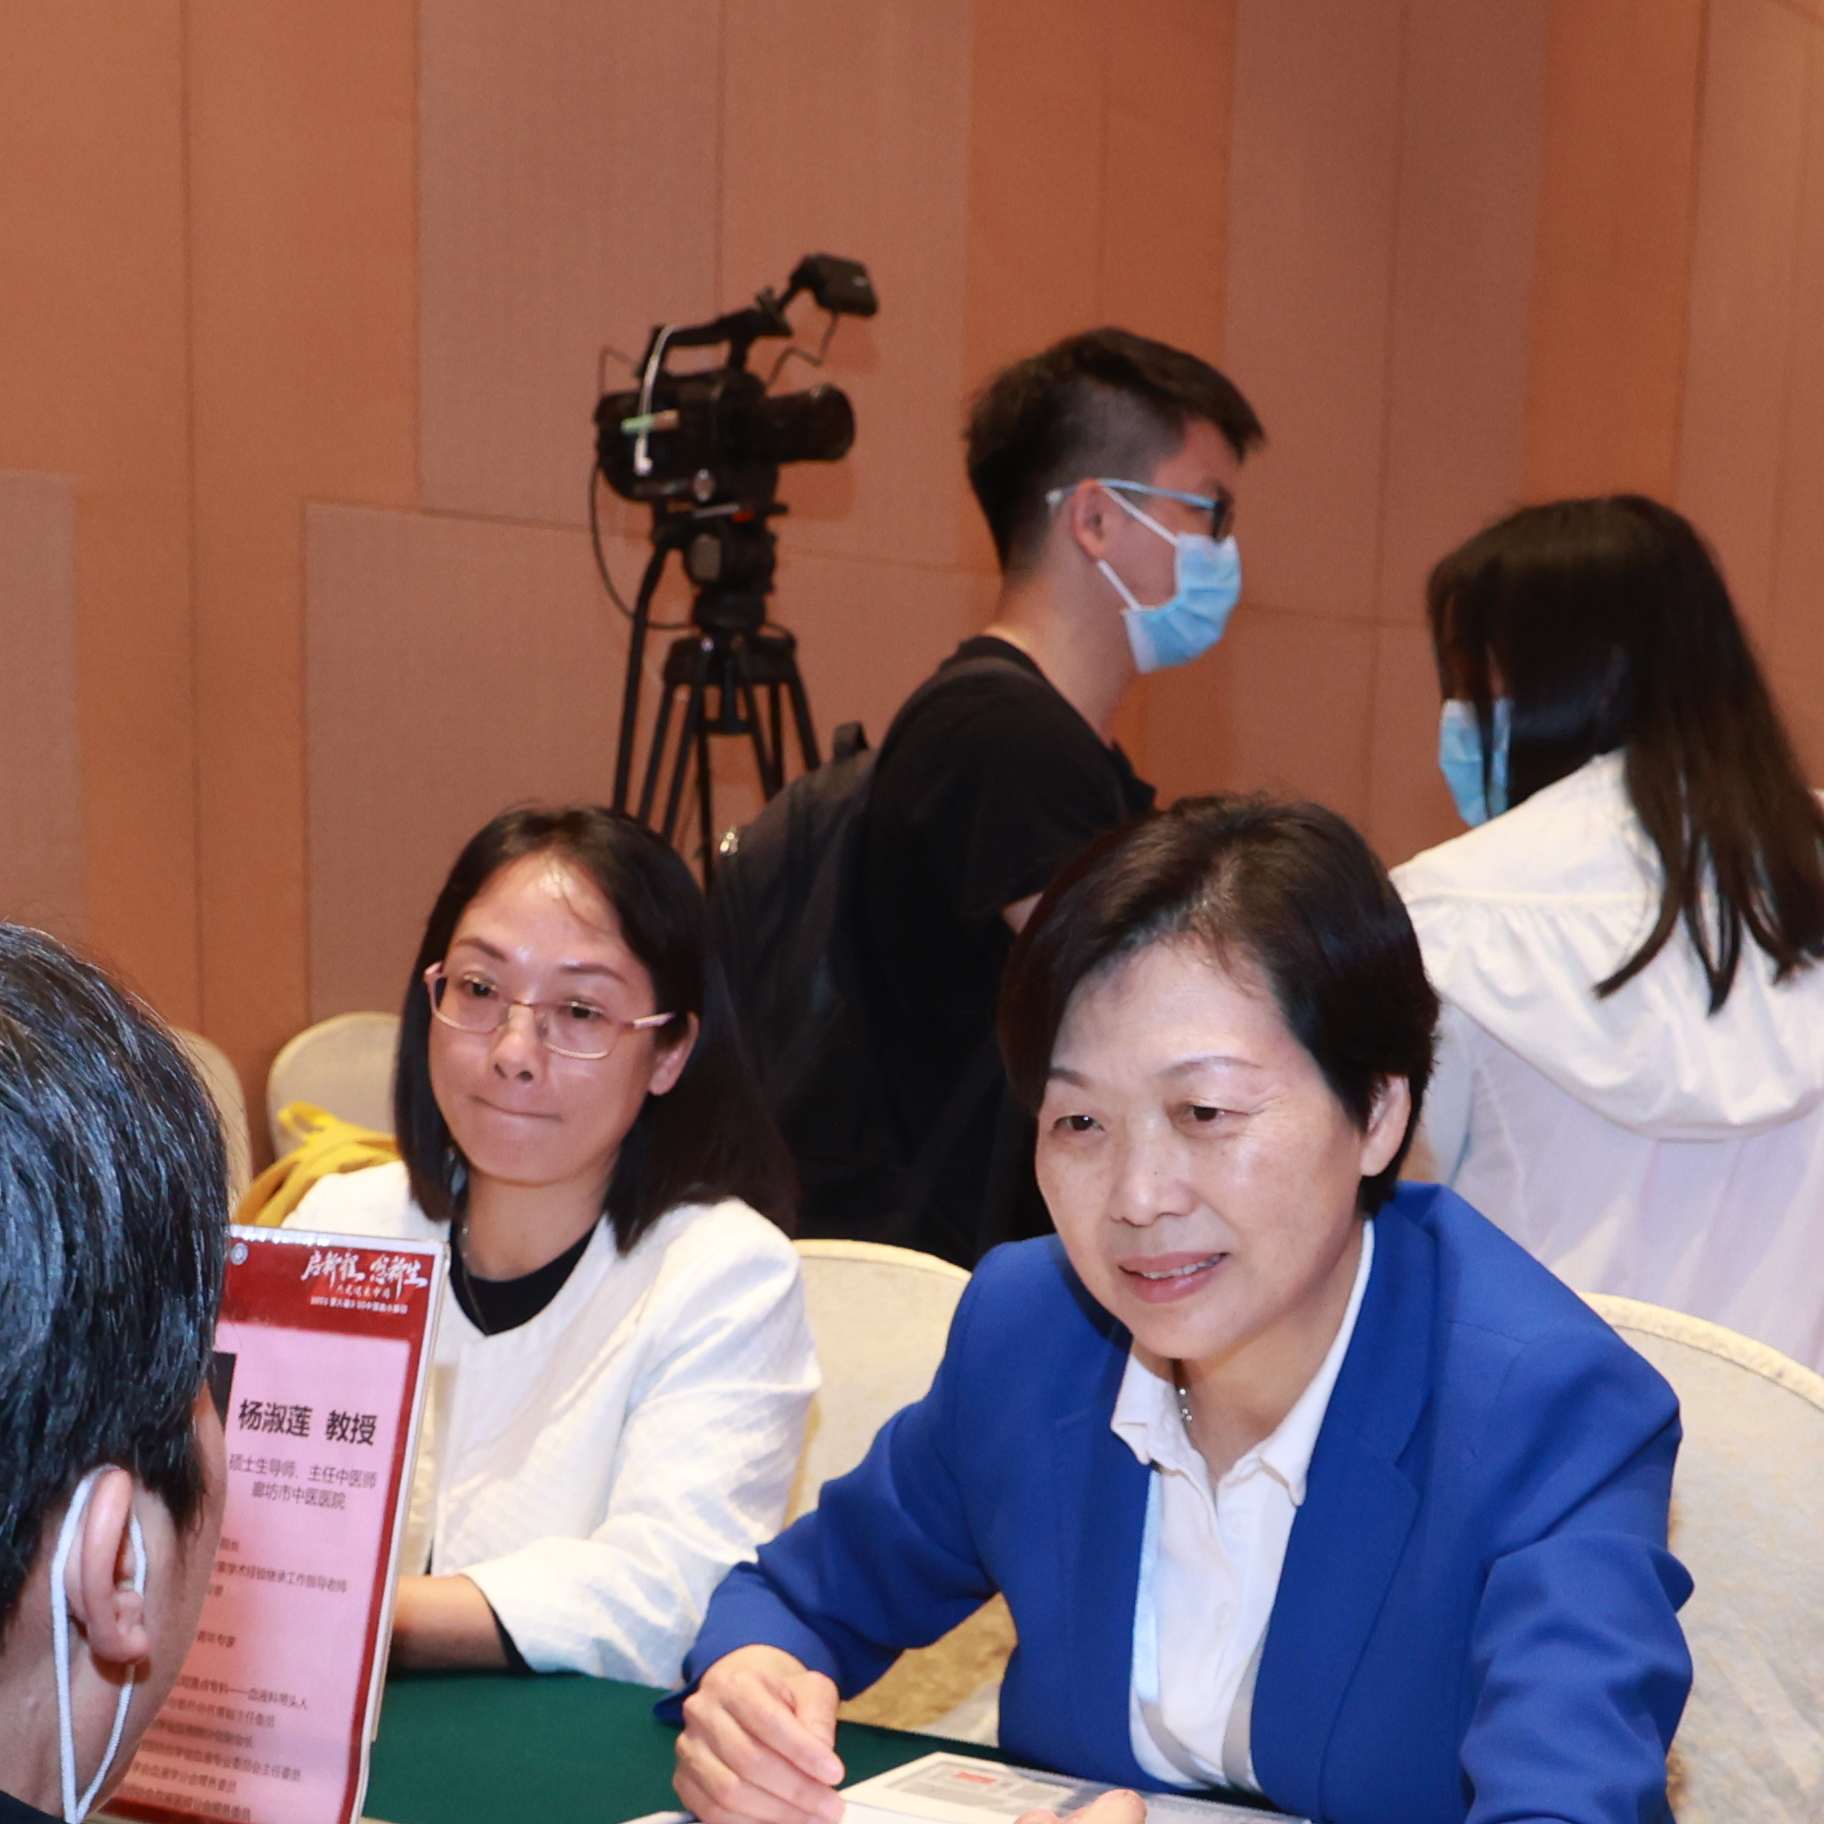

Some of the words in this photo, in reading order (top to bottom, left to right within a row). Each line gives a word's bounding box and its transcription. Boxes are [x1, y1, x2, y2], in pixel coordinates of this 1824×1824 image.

[238, 1398, 313, 1438] 杨淑莲
[325, 1409, 378, 1446] 教授
[252, 1481, 347, 1510] 廊坊市中医医院
